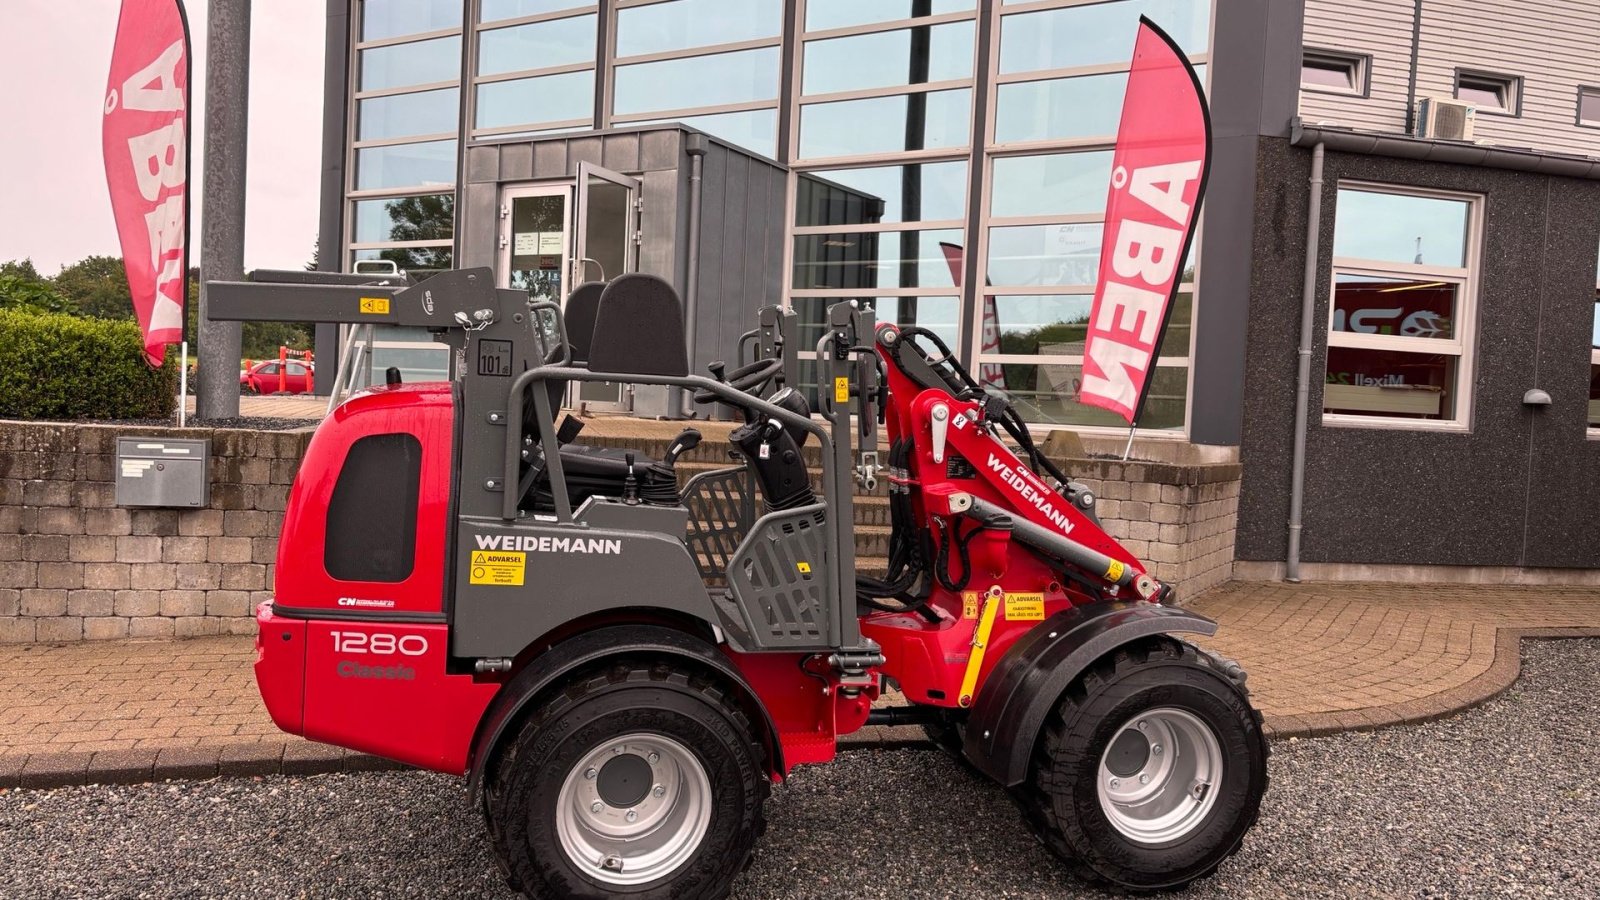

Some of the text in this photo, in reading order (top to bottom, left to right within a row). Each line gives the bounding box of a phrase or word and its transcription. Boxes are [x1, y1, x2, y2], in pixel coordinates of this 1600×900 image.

[481, 355, 500, 374] 101
[986, 452, 1075, 535] WEIDEMANN
[474, 534, 622, 555] WEIDEMANN
[487, 555, 522, 563] ADVARSEL
[337, 597, 356, 606] CN
[330, 631, 429, 656] 1280
[337, 660, 416, 680] Classic
